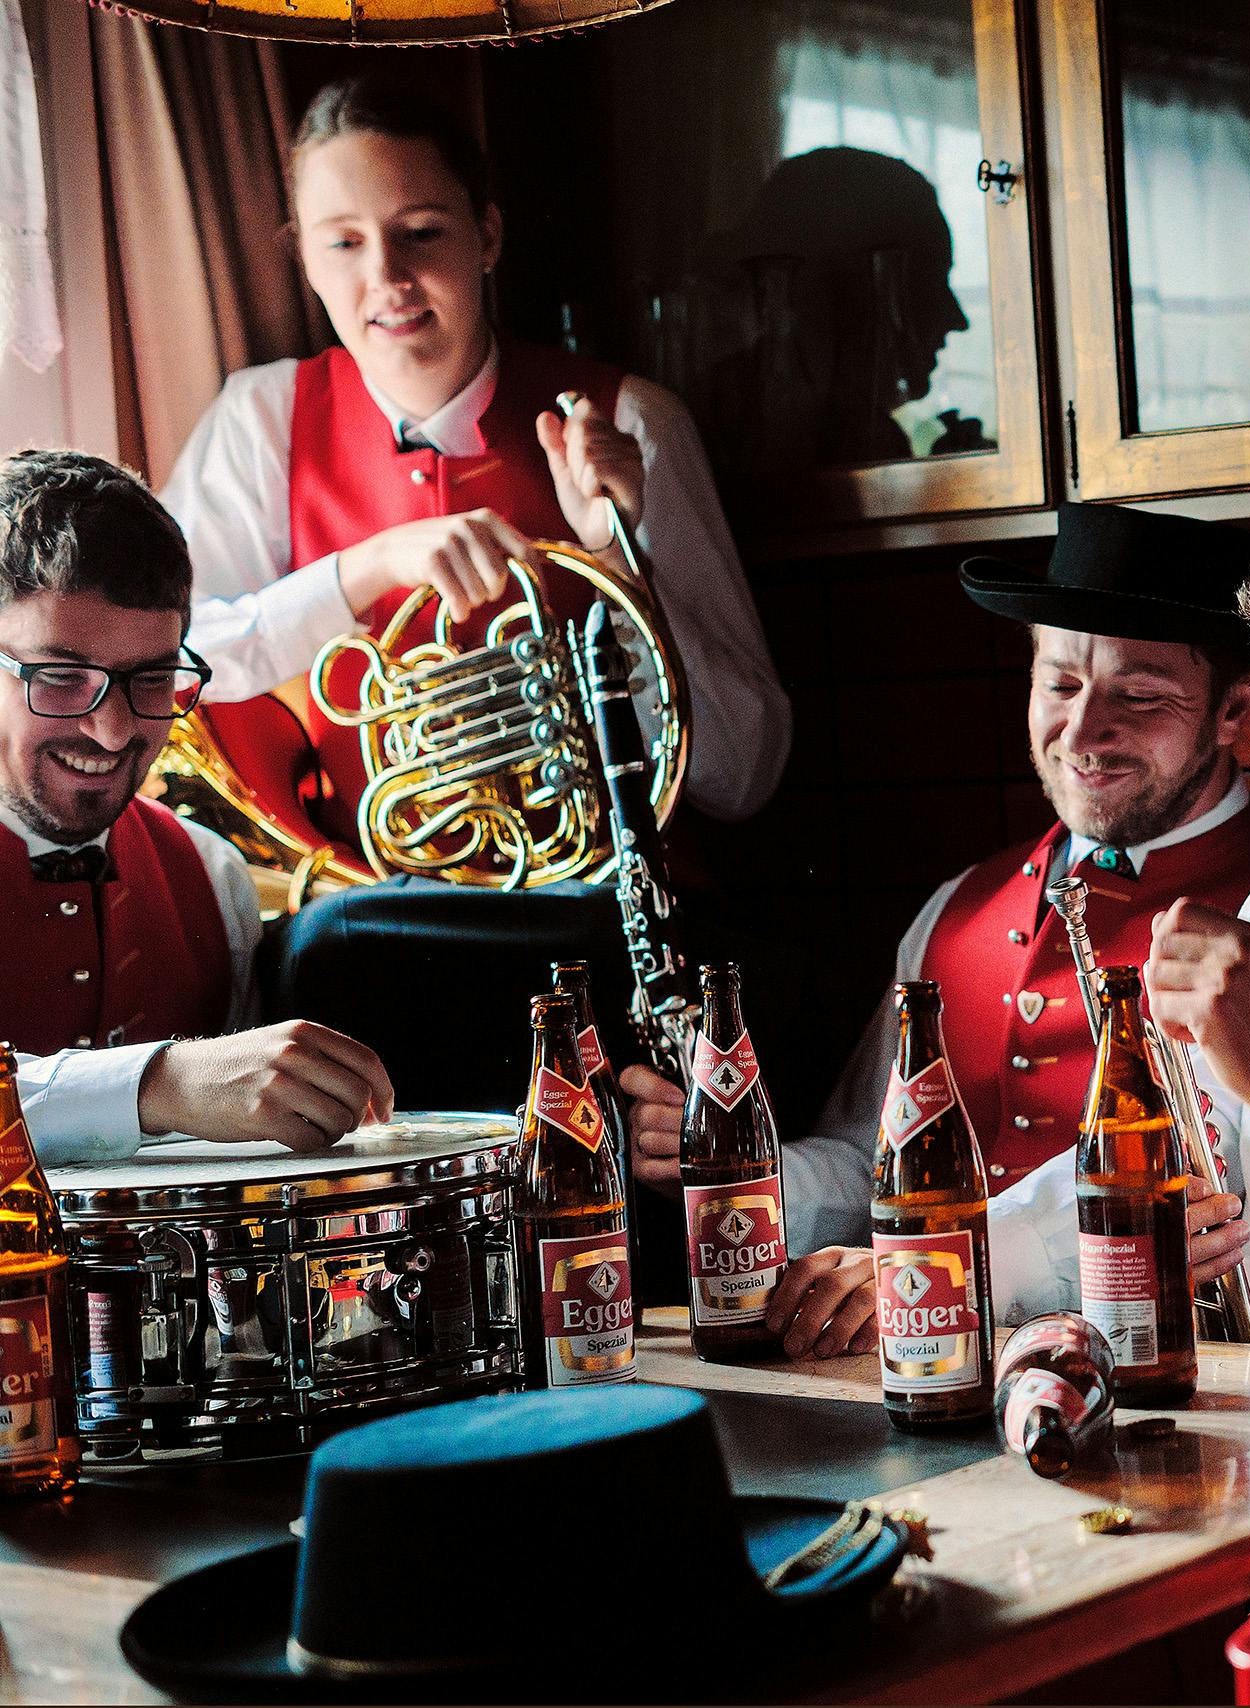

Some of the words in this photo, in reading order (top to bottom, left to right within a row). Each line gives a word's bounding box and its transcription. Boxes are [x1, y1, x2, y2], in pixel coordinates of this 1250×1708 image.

[543, 1090, 569, 1099] Egger
[540, 1100, 572, 1111] Spezial
[699, 1239, 779, 1275] Egger
[720, 1275, 765, 1294] Spezial
[880, 1297, 964, 1337] Egger
[587, 1333, 627, 1354] Spezial
[895, 1342, 940, 1358] Spezial
